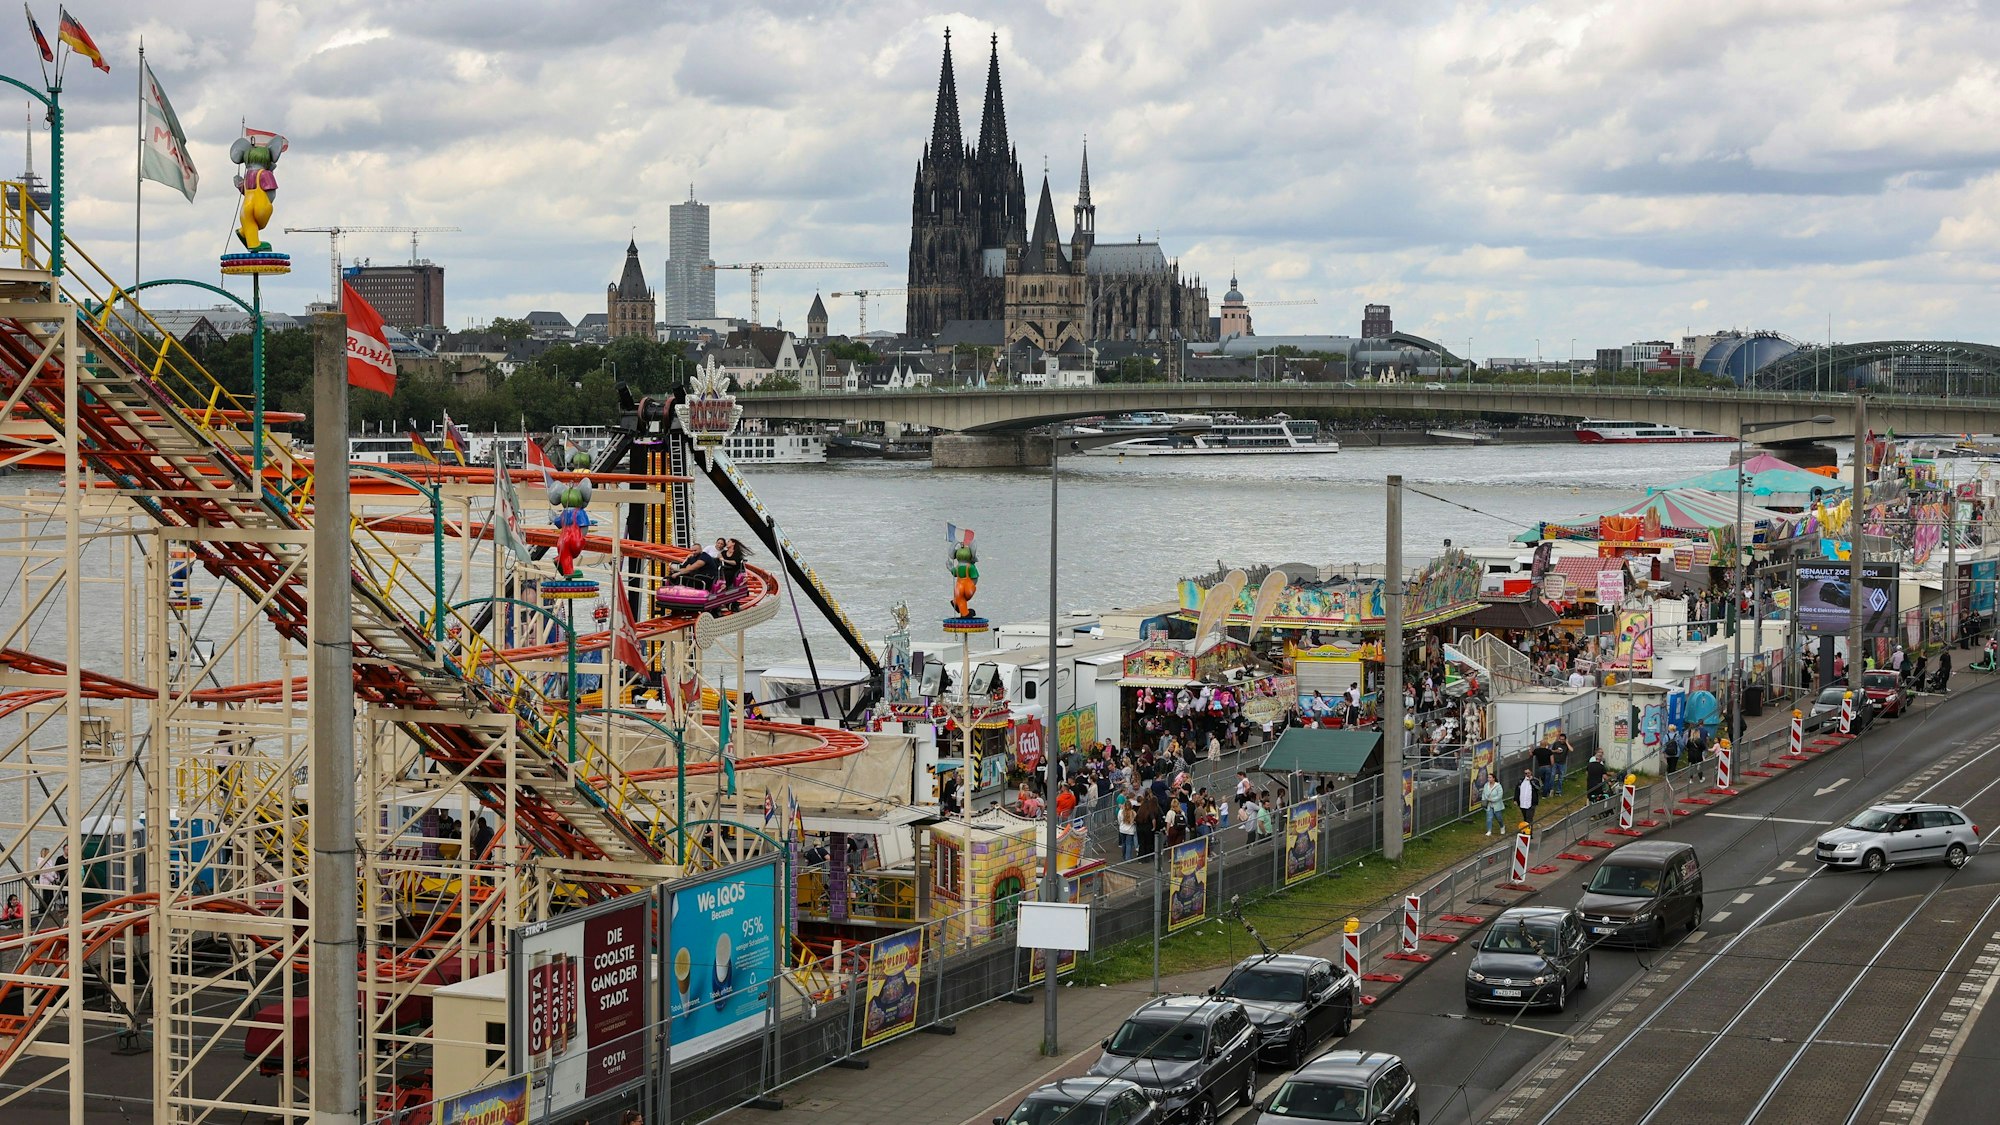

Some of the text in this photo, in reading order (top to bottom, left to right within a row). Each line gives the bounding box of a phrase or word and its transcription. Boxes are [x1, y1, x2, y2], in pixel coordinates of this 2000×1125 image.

[347, 336, 393, 367] Barth
[1019, 729, 1040, 755] früh
[697, 881, 746, 913] We IQOS
[711, 907, 734, 921] Because
[607, 927, 623, 946] DIE
[742, 916, 764, 938] 95%
[594, 944, 635, 970] COOLSTE
[591, 964, 638, 993] GANG DER
[532, 971, 543, 1051] COSTA
[600, 988, 629, 1011] STADT.
[602, 1050, 627, 1068] COSTA
[607, 1064, 622, 1075] COFFEE
